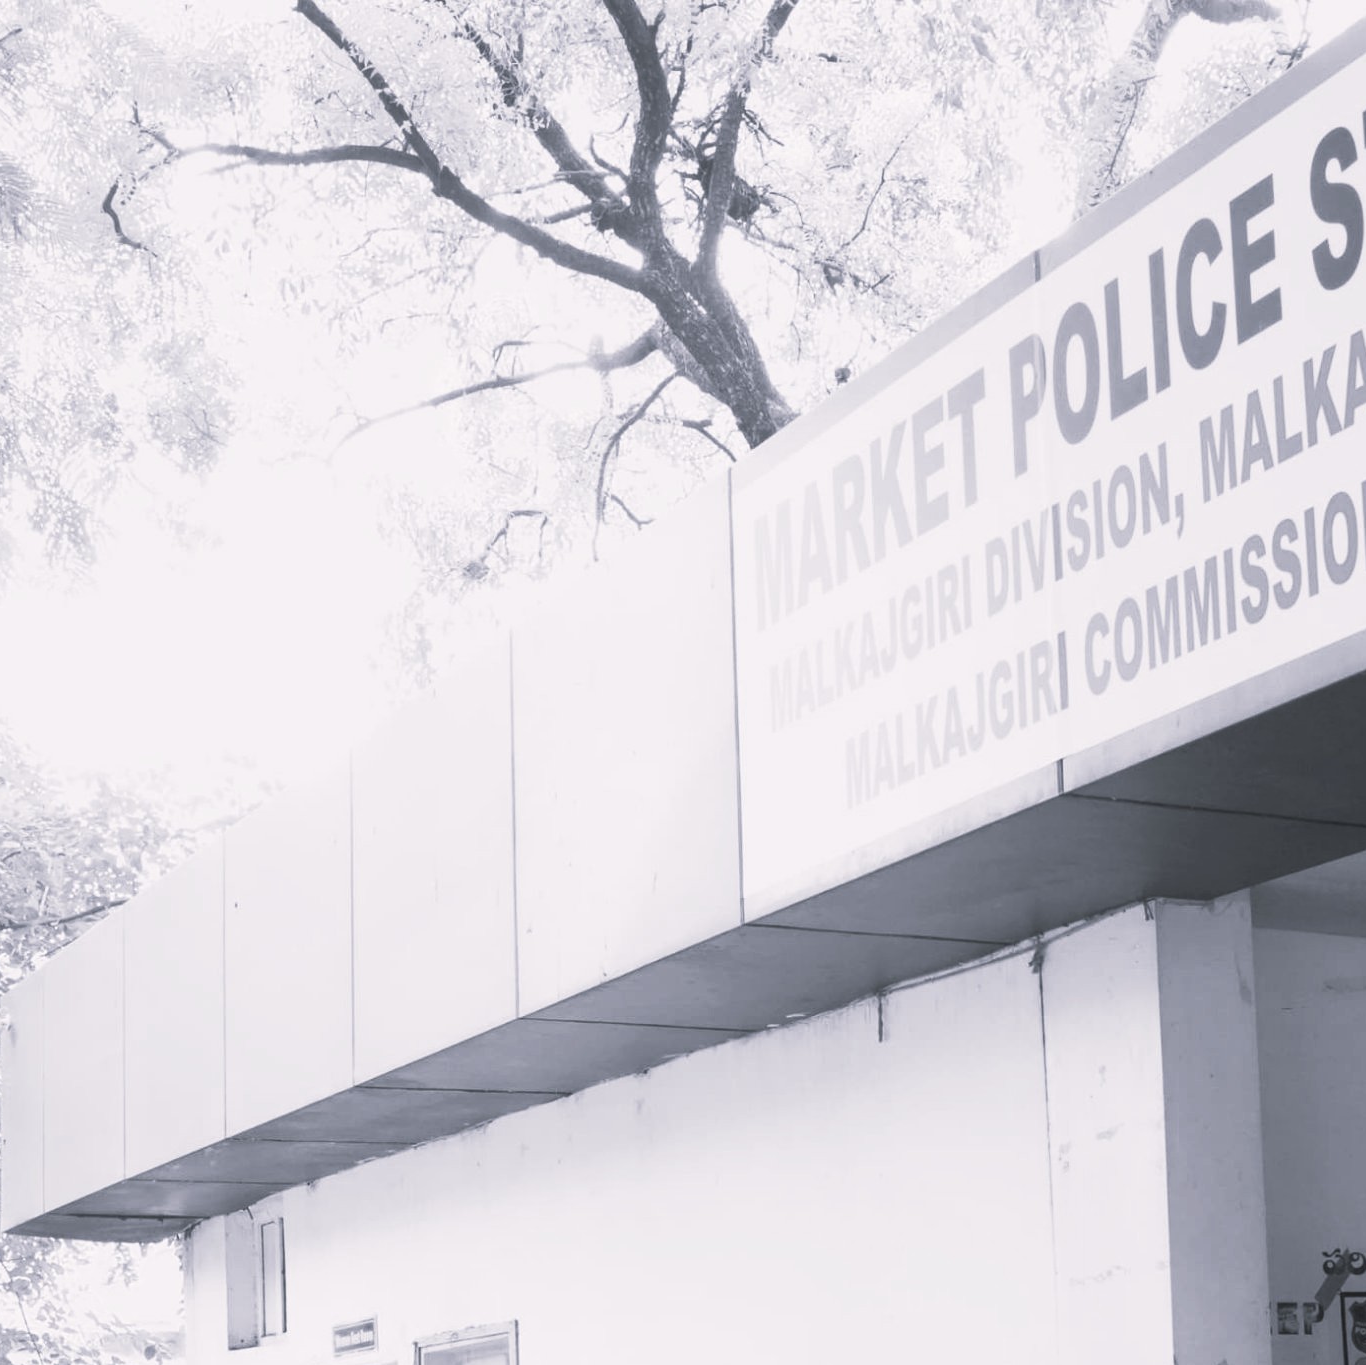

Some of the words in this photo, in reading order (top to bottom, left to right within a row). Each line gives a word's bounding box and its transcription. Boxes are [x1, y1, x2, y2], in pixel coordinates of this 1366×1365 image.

[753, 366, 985, 632] MARKET
[1009, 174, 1282, 479] POLICE
[769, 555, 973, 733] MALKAJGIRI
[984, 442, 1185, 618] DIVISION,
[845, 631, 1069, 810] MALKAJGIRI
[1269, 1302, 1325, 1336] EP
